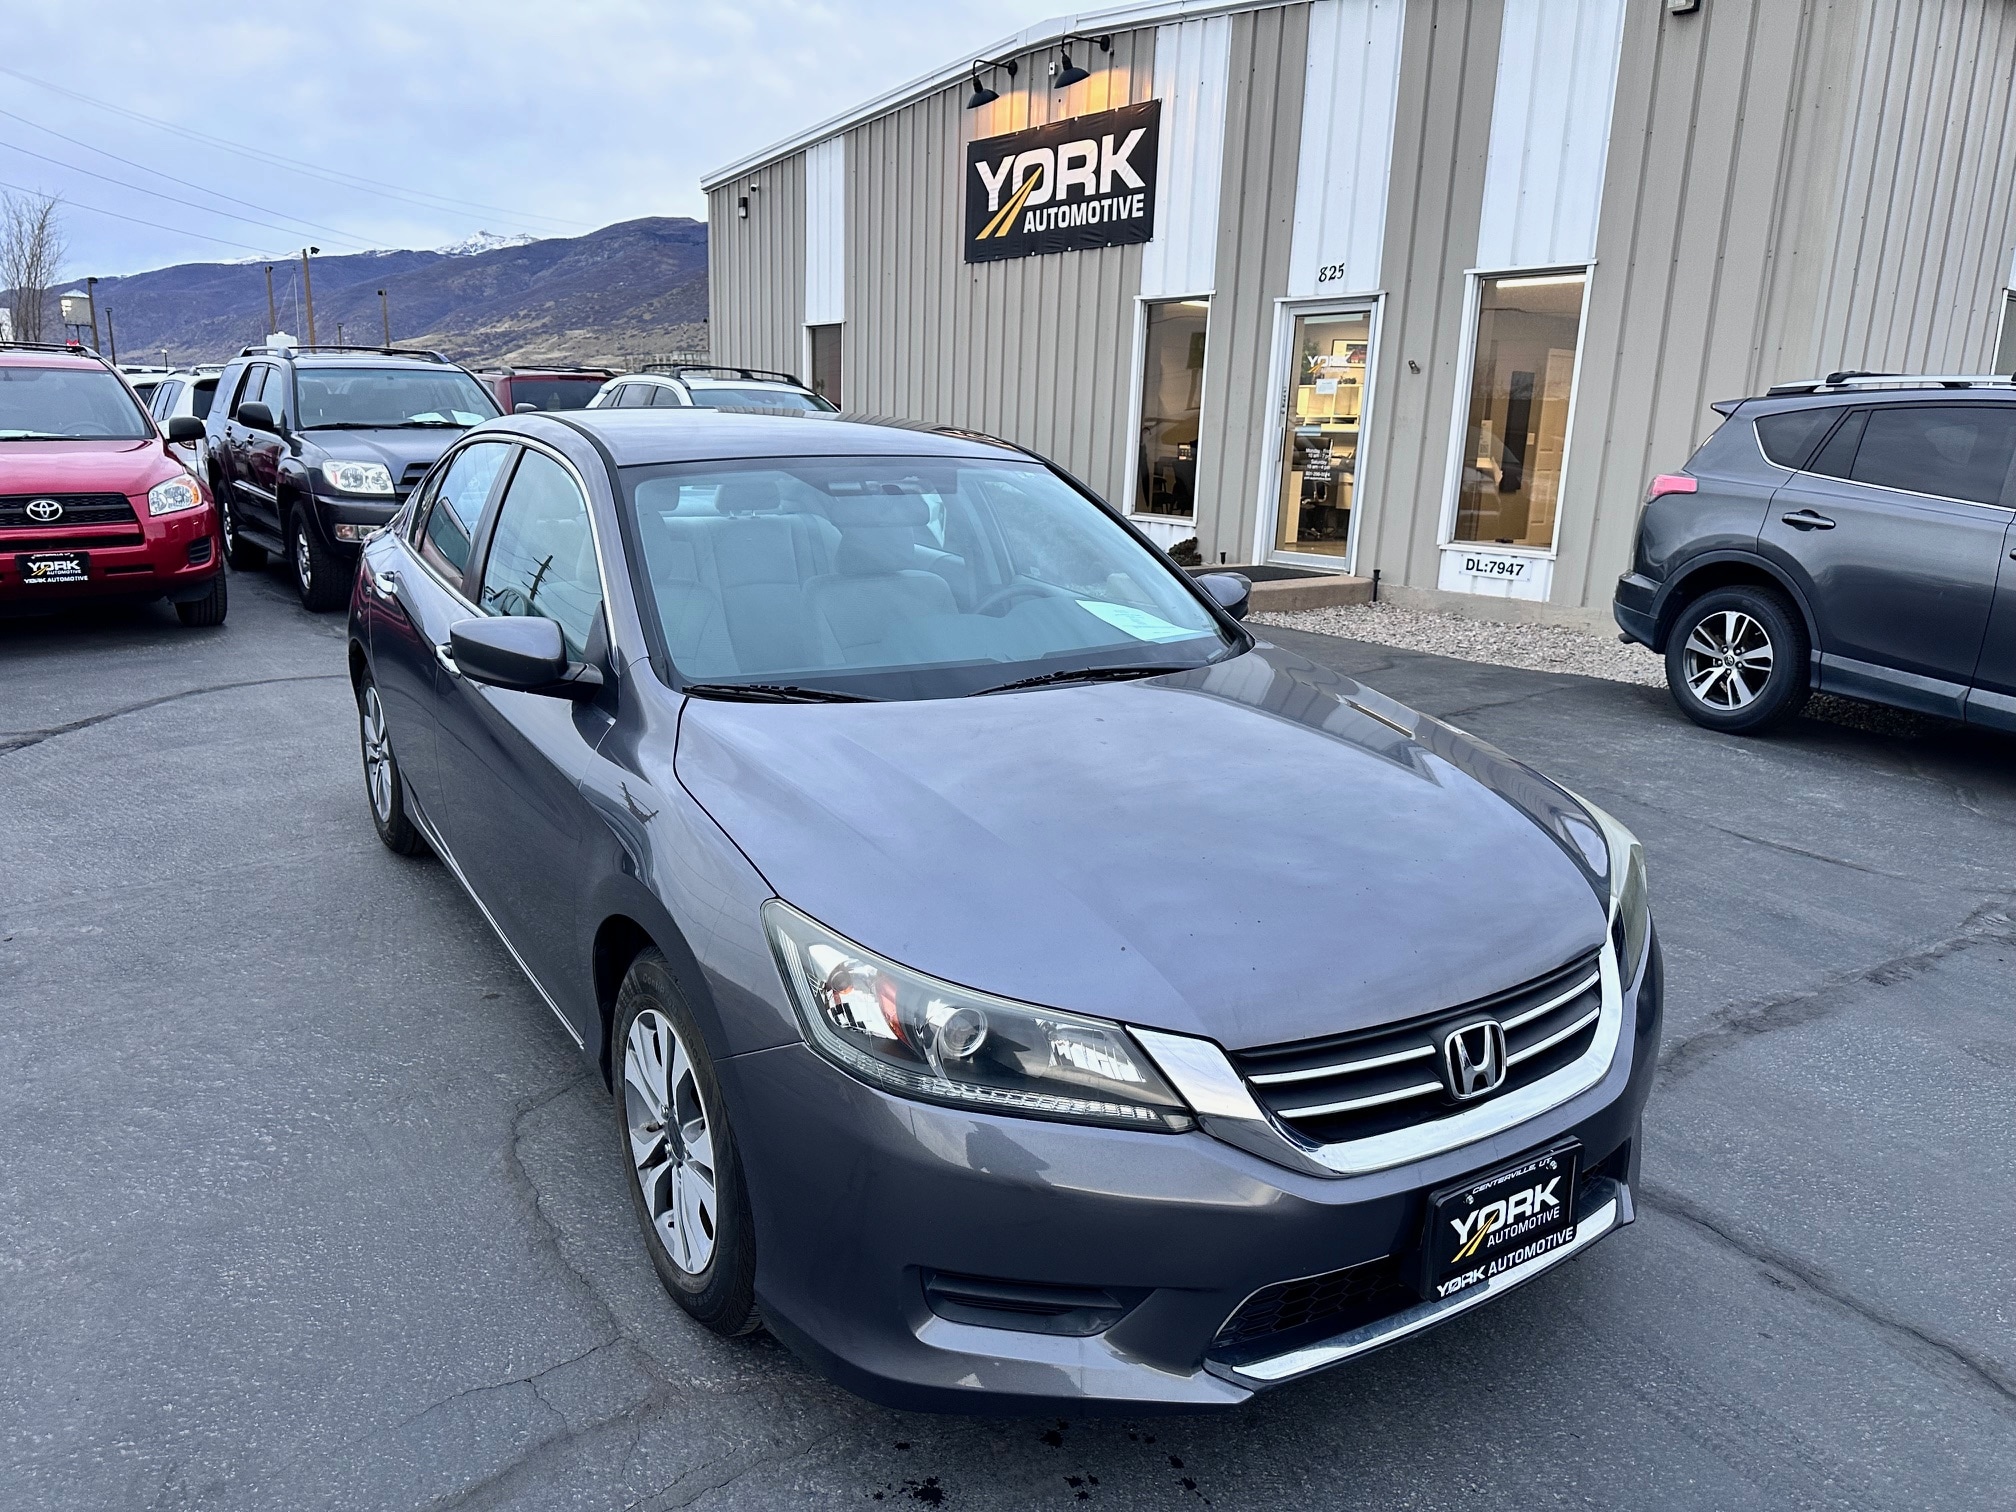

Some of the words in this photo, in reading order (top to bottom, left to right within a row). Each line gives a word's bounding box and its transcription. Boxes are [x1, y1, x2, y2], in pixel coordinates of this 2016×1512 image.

[975, 127, 1147, 212] YORK
[1023, 193, 1144, 234] AUTOMOTIVE
[1318, 262, 1345, 283] 825
[27, 560, 81, 571] YORK
[46, 575, 88, 583] AUTOMOTIVE
[1465, 558, 1524, 576] DL:7947
[1450, 1175, 1561, 1245] YORK
[1486, 1206, 1560, 1248] AUTOMOTIVE
[1436, 1265, 1486, 1297] YORK
[1487, 1226, 1574, 1277] AUTOMOTIVE
